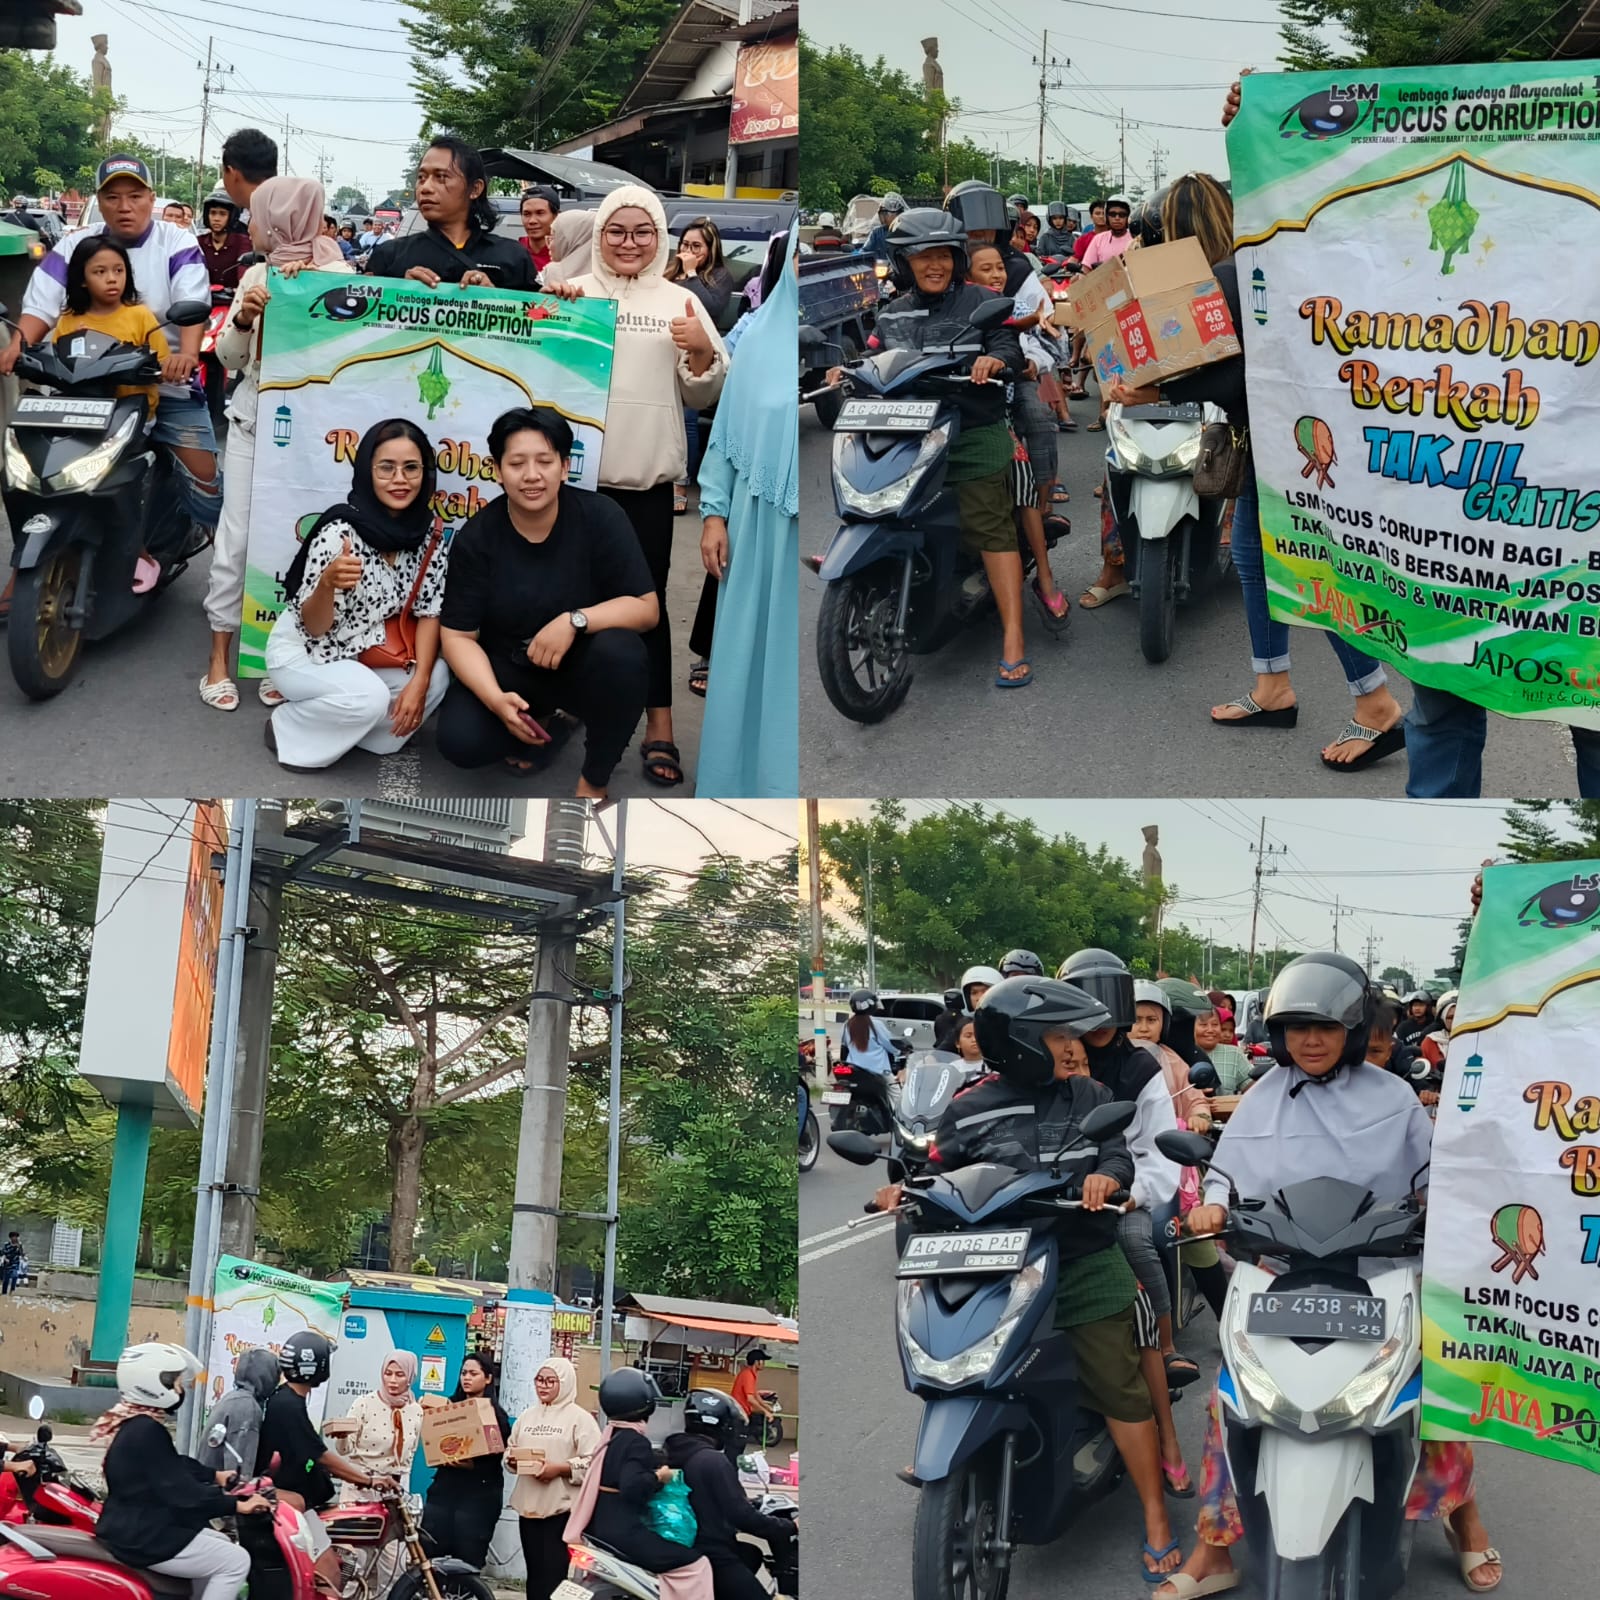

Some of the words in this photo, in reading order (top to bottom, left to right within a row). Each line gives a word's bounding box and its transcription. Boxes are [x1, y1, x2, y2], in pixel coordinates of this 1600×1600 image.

[1330, 82, 1380, 102] LSM
[1452, 85, 1506, 103] Swadaya
[1509, 82, 1584, 101] Masyarakat
[1372, 105, 1448, 133] FOCUS
[1455, 101, 1600, 132] CORRUPTIO
[346, 284, 383, 298] LSM
[433, 296, 469, 310] Swadaya
[471, 299, 516, 314] Masyarakat
[377, 303, 430, 325] FOCUS
[435, 308, 533, 337] CORRUPTION
[1205, 308, 1224, 324] 48
[1210, 321, 1226, 333] CUP
[1129, 327, 1144, 347] 48
[1299, 295, 1600, 367] Ramadhan
[1134, 345, 1148, 360] CUP
[22, 402, 40, 411] AG
[848, 404, 866, 414] AG
[906, 404, 933, 415] PAP
[1339, 360, 1541, 433] Berkah
[1363, 426, 1527, 490] TAKJIL
[1463, 480, 1600, 532] GRATIS
[1285, 489, 1320, 511] LSM
[1321, 498, 1373, 529] FOCUS
[1379, 515, 1494, 559] CORUPTION
[1502, 542, 1562, 567] BAGI
[1342, 533, 1400, 567] GRATIS
[1405, 553, 1511, 593] BERSAMA
[1275, 537, 1335, 567] HARIAN
[1336, 557, 1377, 584] JAYA
[1382, 569, 1407, 598] POS
[1412, 585, 1426, 606] &
[1432, 590, 1569, 634] WARTAWAN
[1360, 602, 1408, 653] POS
[912, 1241, 936, 1255] AG
[940, 1238, 983, 1252] 2036
[989, 1236, 1022, 1250] PAP
[1290, 1297, 1342, 1314] 4538
[1356, 1300, 1383, 1319] NX
[1464, 1286, 1511, 1306] LSM
[1514, 1292, 1580, 1323] FOCUS
[1325, 1321, 1381, 1336] 11-25
[1463, 1314, 1532, 1343] TAKJIL
[1441, 1340, 1519, 1367] HARIAN
[1523, 1355, 1576, 1381] JAYA
[1470, 1386, 1544, 1434] JAYA
[1551, 1402, 1600, 1443] PO
